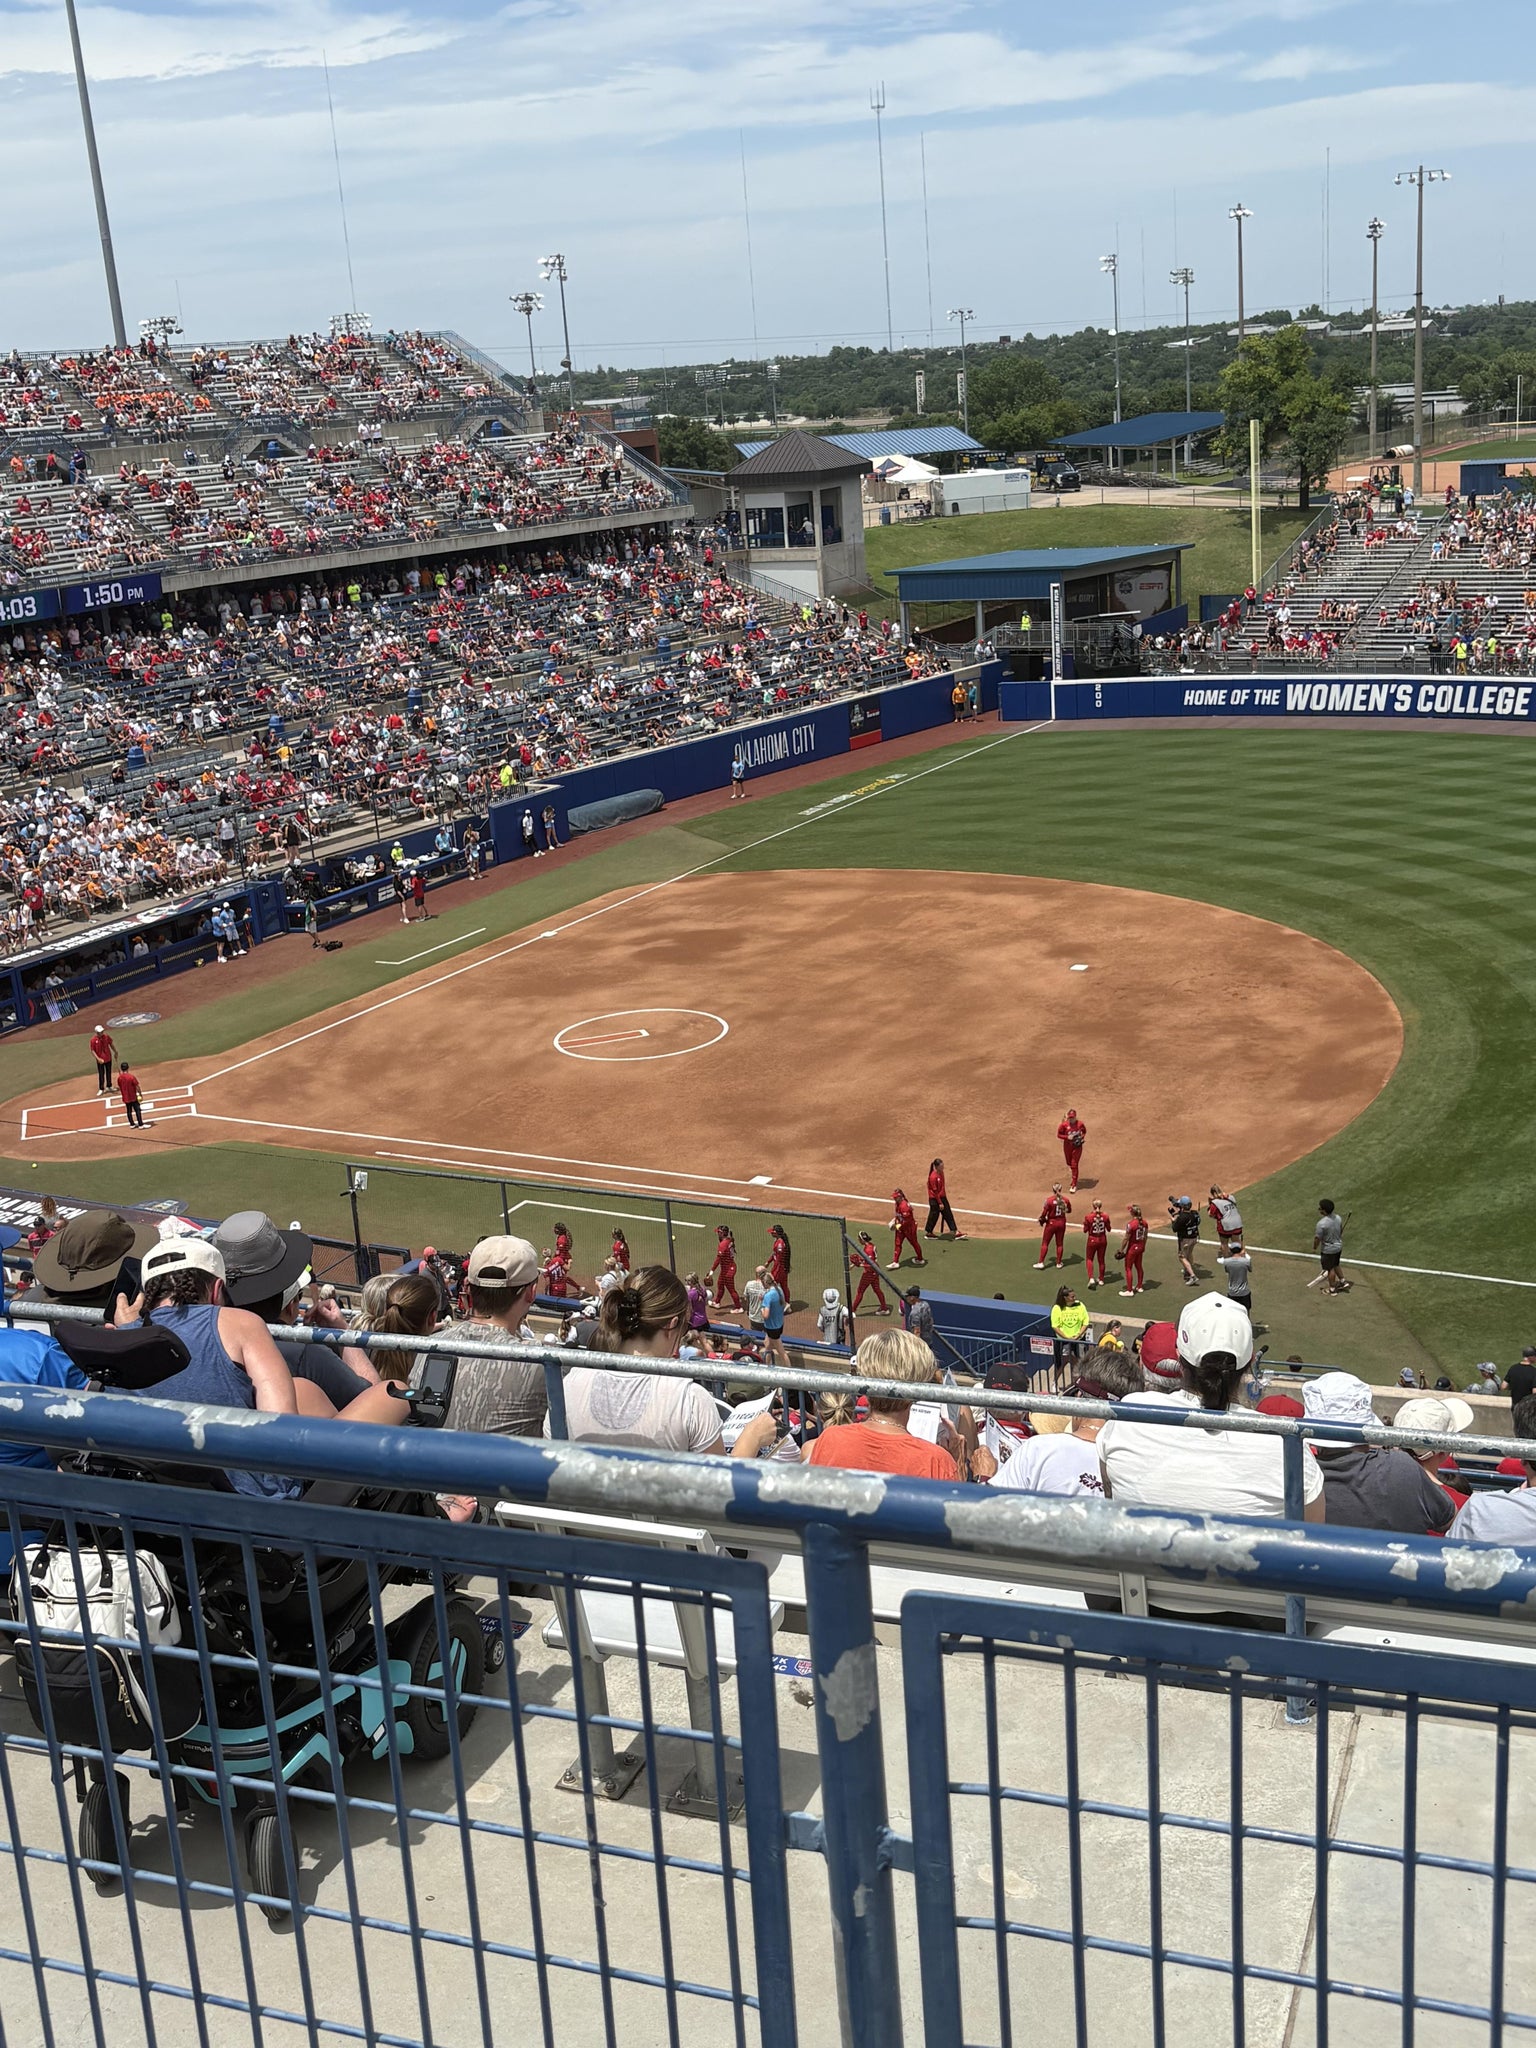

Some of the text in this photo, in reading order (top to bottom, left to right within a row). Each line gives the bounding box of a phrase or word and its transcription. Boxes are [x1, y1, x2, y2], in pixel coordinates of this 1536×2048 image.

[83, 582, 144, 607] 1:50 PM
[1139, 582, 1164, 591] ESPN
[1183, 683, 1533, 716] HOME OF THE WOMEN'S COLLEGE
[734, 731, 790, 768] OKLAHOMA
[791, 723, 816, 755] CITY
